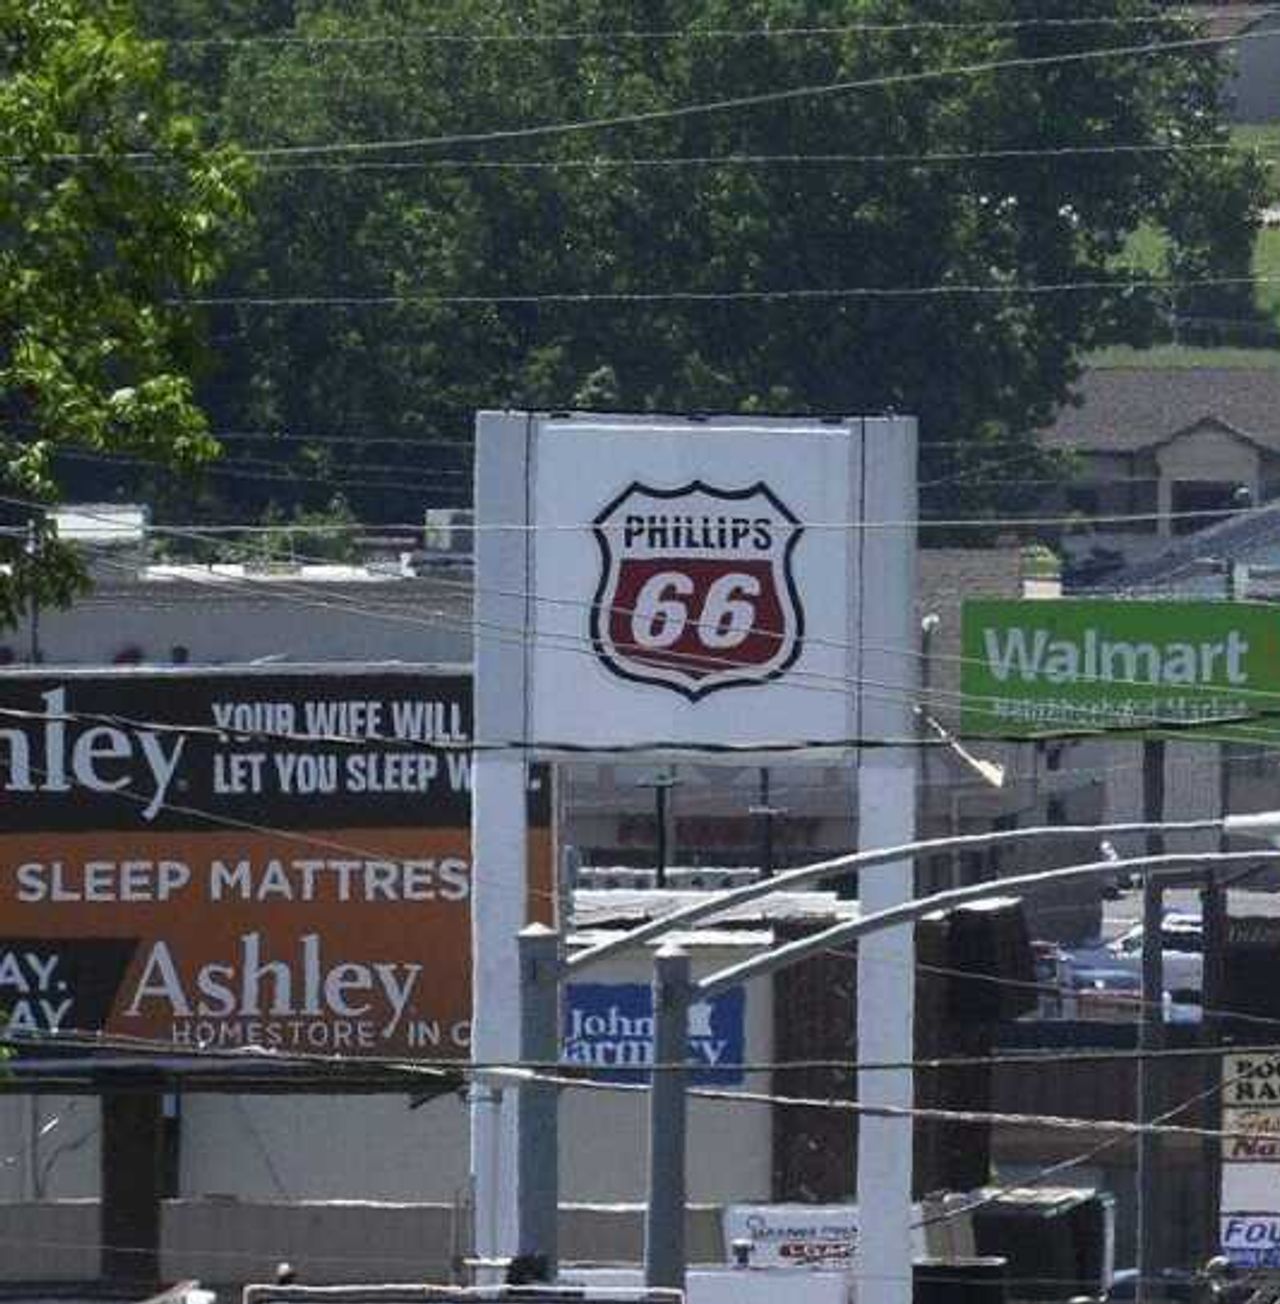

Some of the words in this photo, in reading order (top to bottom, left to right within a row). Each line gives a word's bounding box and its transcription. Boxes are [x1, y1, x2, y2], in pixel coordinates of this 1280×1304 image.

[623, 515, 773, 550] PHILLIPS
[631, 571, 761, 650] 66
[982, 627, 1249, 685] Walmart
[212, 701, 295, 742] YOUR
[305, 701, 385, 739] WIFE
[391, 702, 468, 741] WILL
[213, 753, 266, 793] LET
[274, 753, 337, 793] YOU
[346, 752, 437, 792] SLEEP
[16, 860, 192, 901] SLEEP
[123, 931, 424, 1039] Ashley
[171, 1021, 376, 1048] HOMESTORE
[407, 1019, 441, 1046] IN
